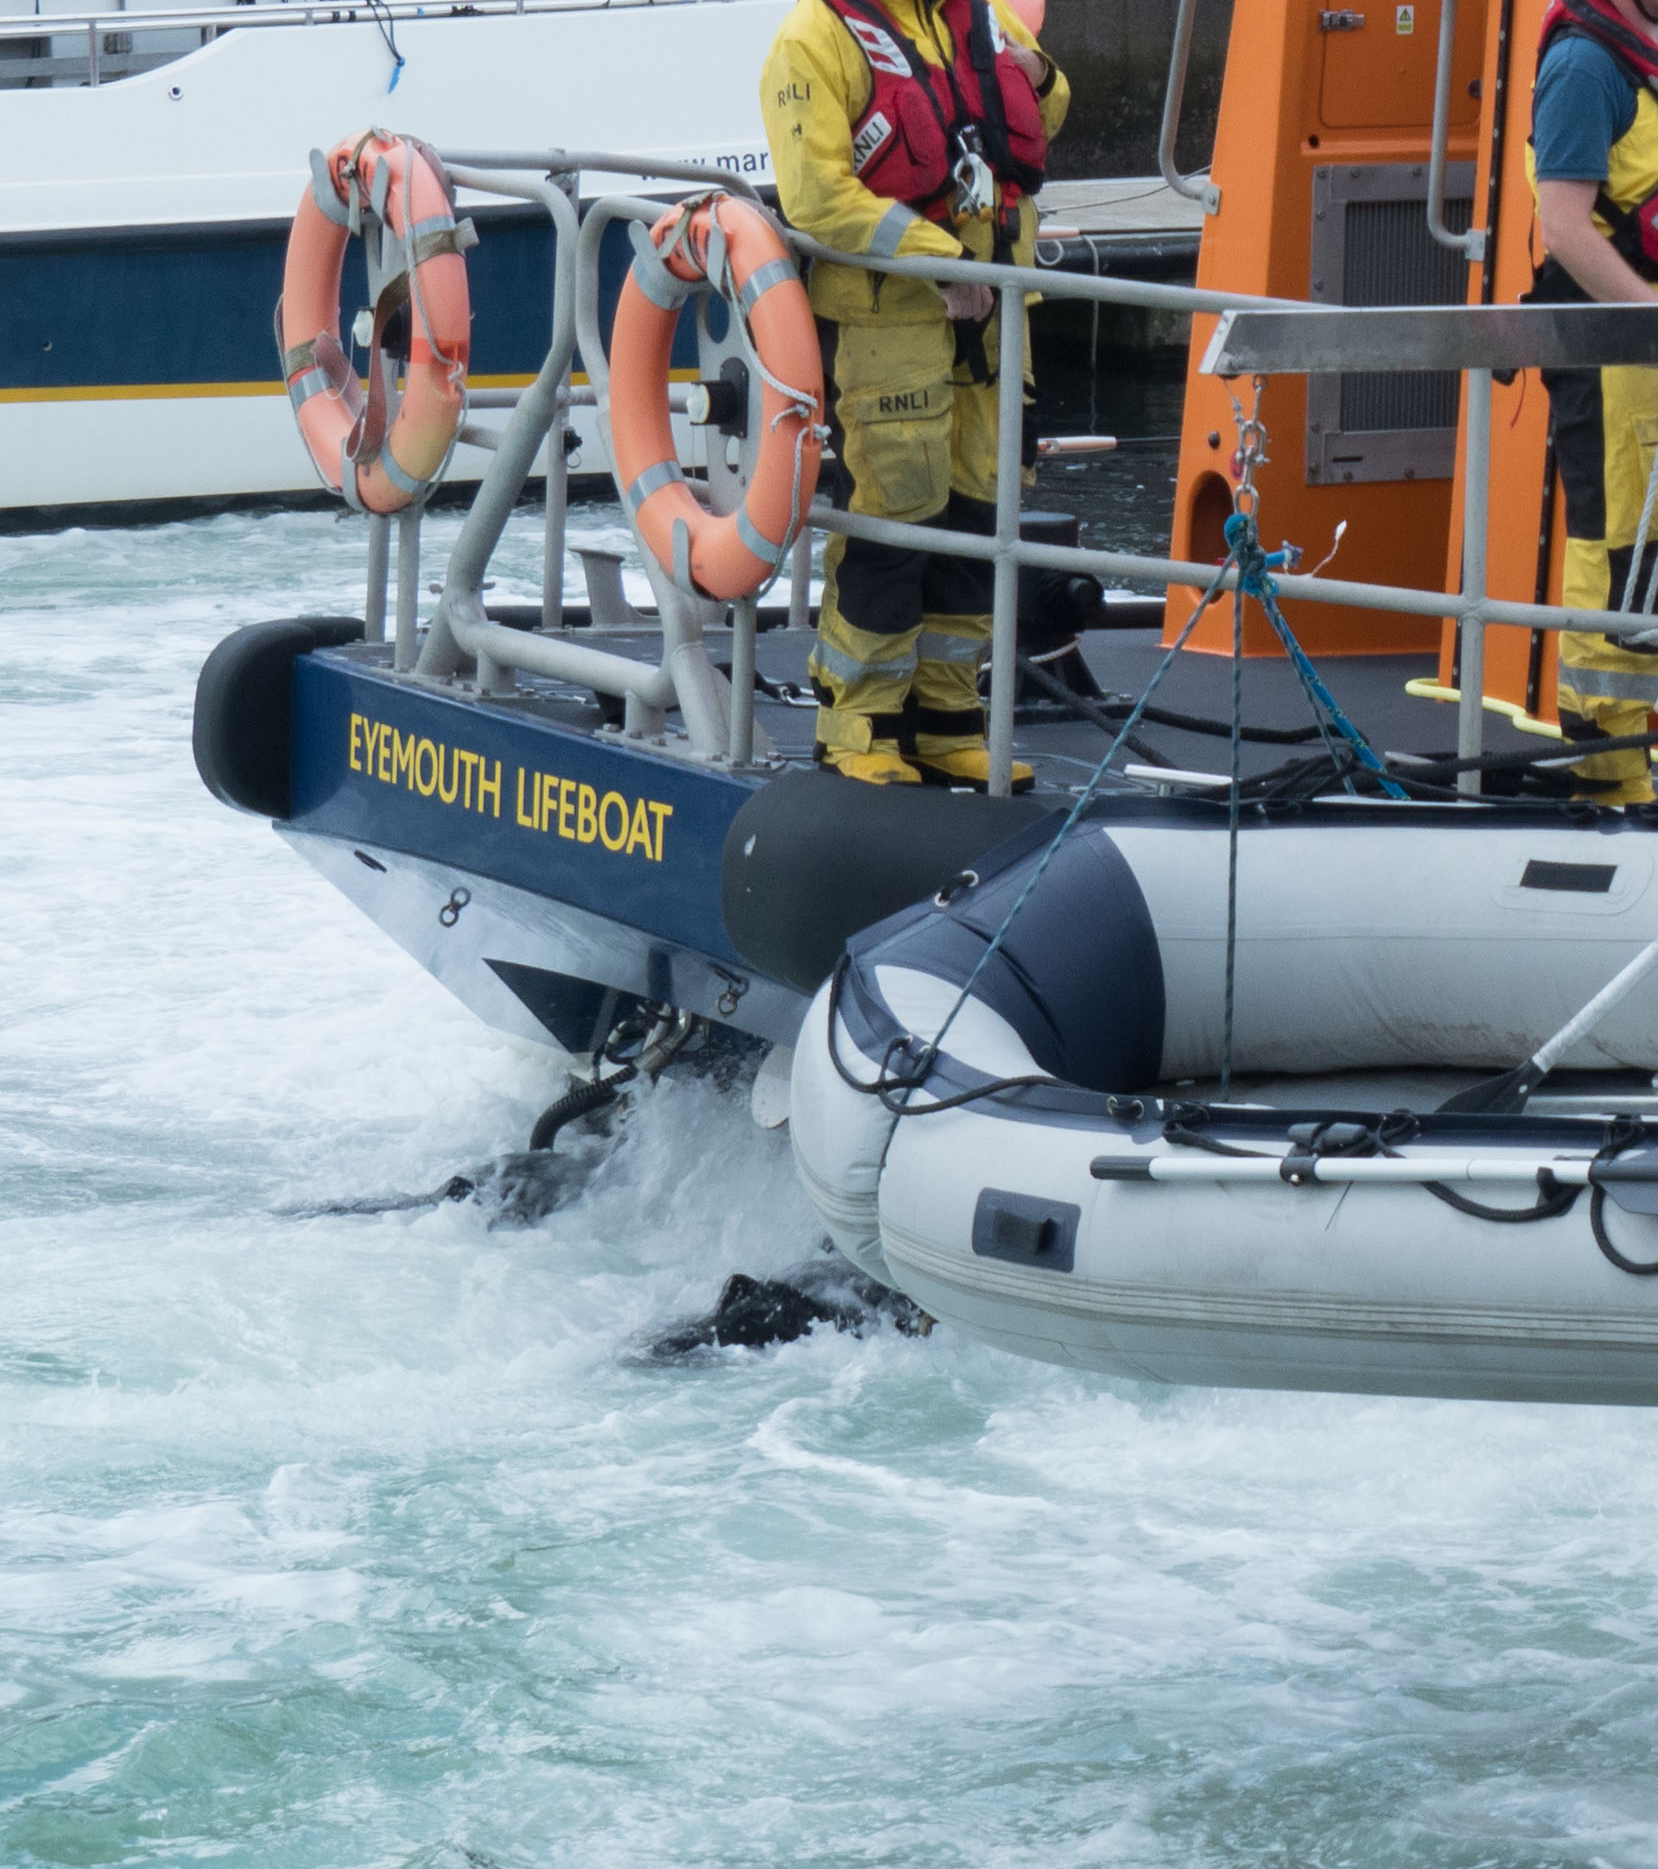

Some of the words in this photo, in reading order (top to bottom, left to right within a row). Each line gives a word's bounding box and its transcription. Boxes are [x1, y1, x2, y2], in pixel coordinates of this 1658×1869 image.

[879, 390, 928, 413] RNLI
[350, 713, 502, 818] EYEMOUTH
[517, 767, 674, 862] LIFEBOAT
